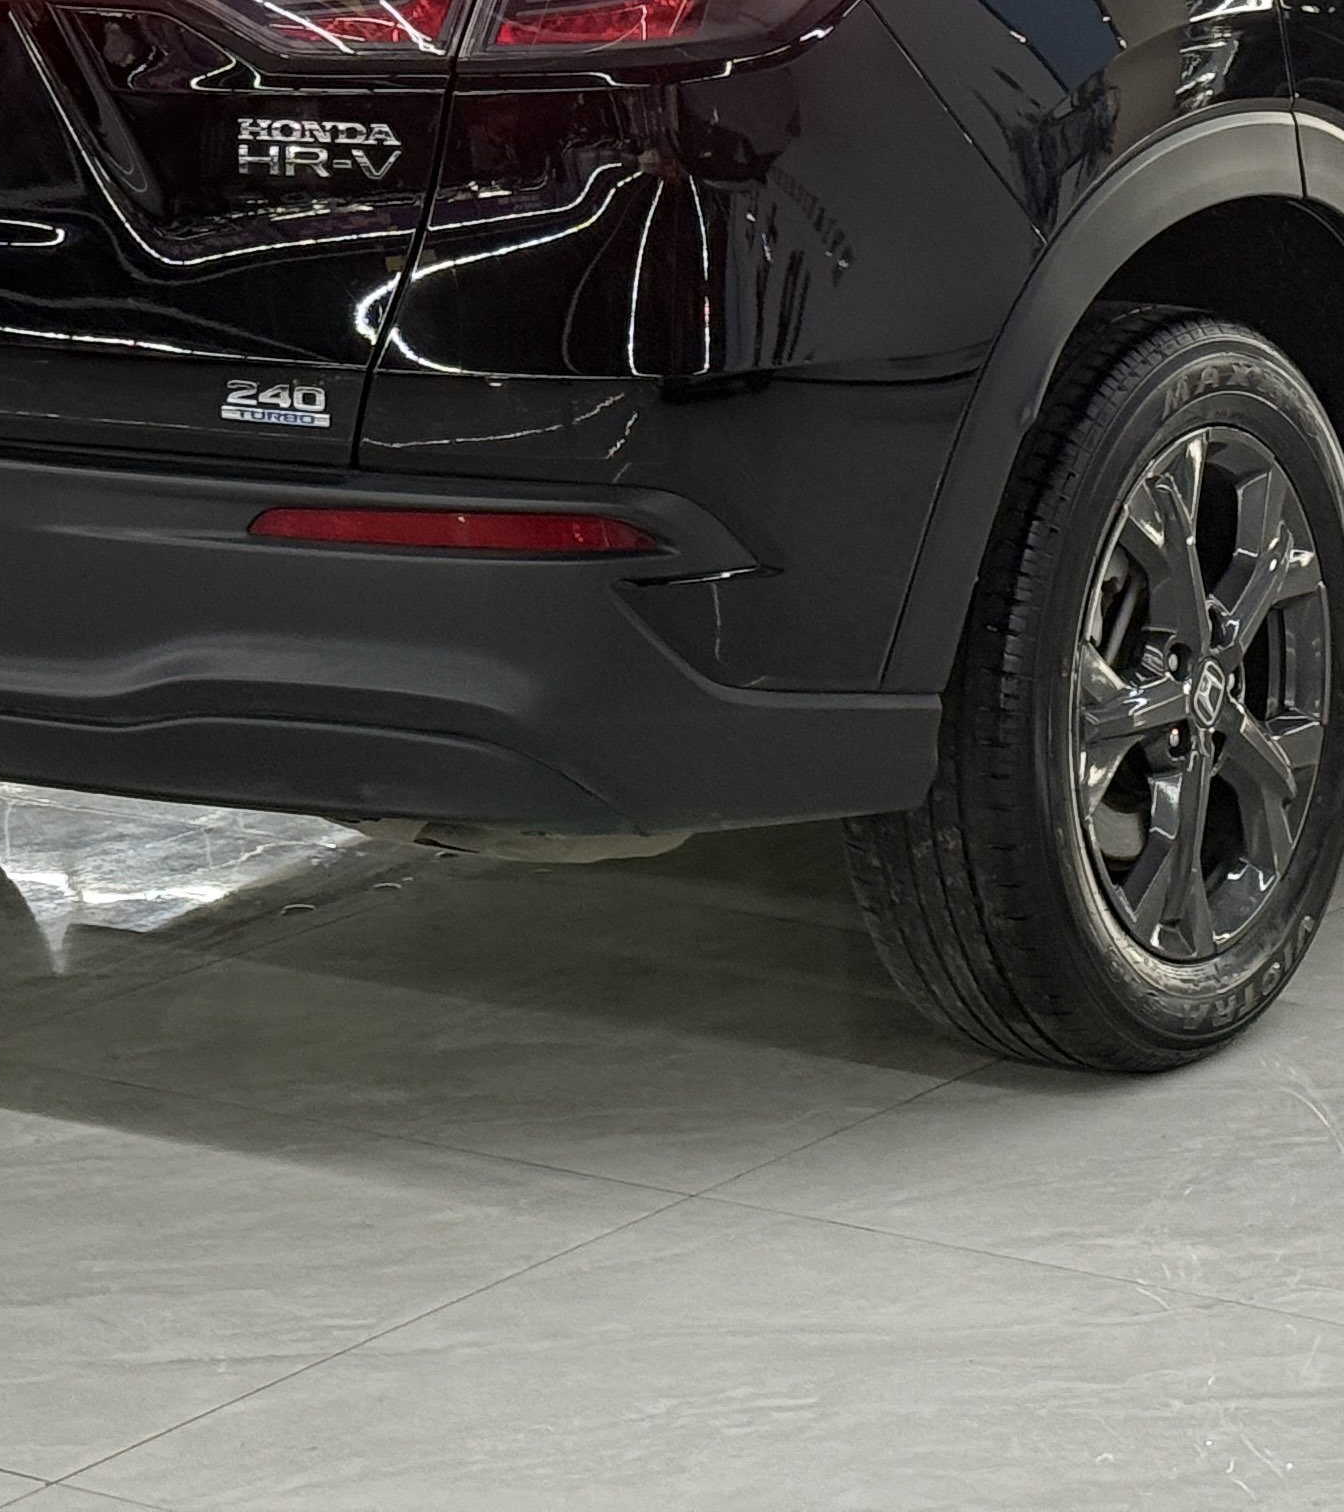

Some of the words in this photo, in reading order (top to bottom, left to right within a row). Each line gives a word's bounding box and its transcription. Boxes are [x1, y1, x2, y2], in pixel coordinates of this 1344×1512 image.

[237, 118, 402, 146] HONDA
[238, 144, 402, 180] HR-V
[227, 379, 326, 412] 240
[240, 408, 316, 425] TURBO
